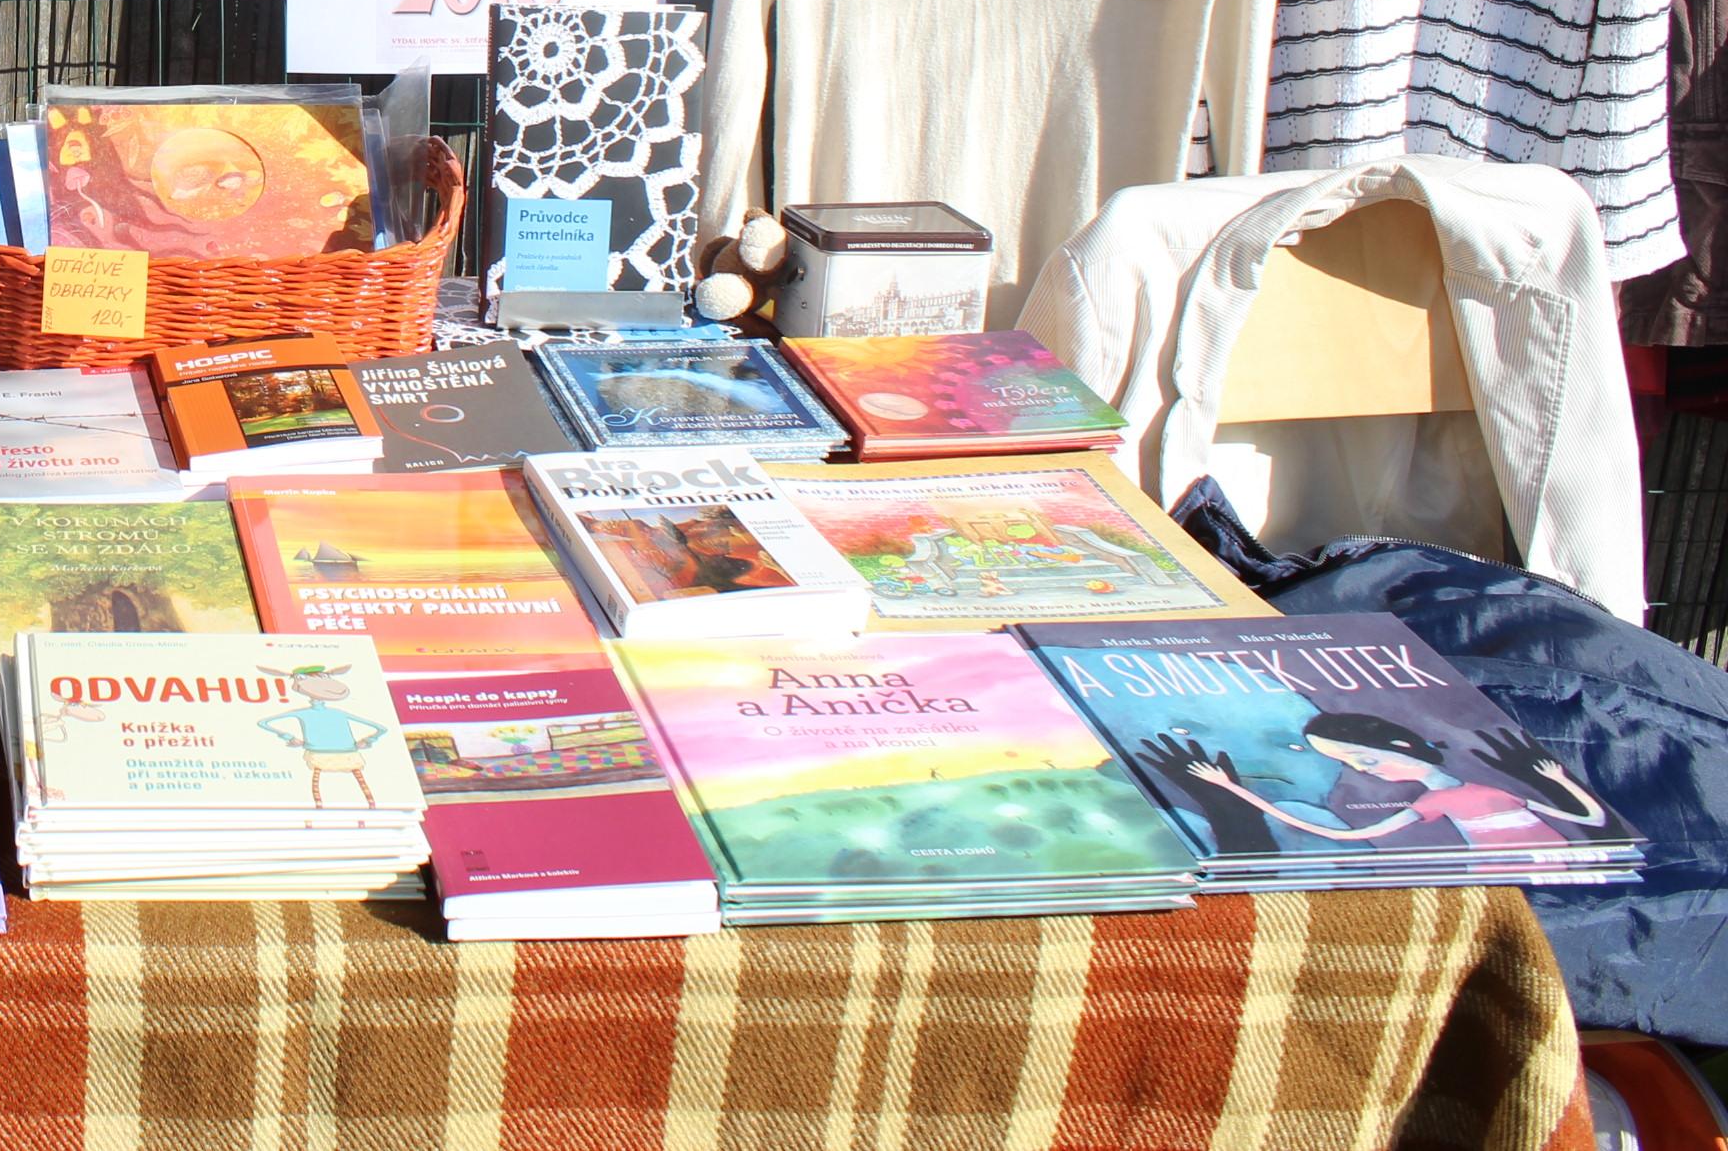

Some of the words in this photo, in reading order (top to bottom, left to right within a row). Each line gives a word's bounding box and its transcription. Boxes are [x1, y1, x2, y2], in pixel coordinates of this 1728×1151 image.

[519, 209, 589, 224] Průvodce
[518, 229, 594, 242] smrtelníka
[52, 252, 126, 276] OTÁČIVÉ
[50, 278, 132, 302] OBRÁZKY
[175, 349, 273, 371] HOSPIC
[361, 368, 420, 382] Jiřina
[427, 355, 507, 377] Šiklová
[362, 371, 494, 393] VYHOŠTĚNÁ
[20, 390, 62, 398] Frankl
[370, 391, 430, 406] SMRT
[8, 456, 73, 469] životu
[80, 457, 120, 467] ano
[586, 457, 639, 471] Ira
[544, 459, 767, 498] Byock
[560, 482, 661, 499] Dobré
[644, 487, 777, 506] umírání
[12, 517, 25, 526] V
[36, 513, 187, 527] KORUNÁCH
[43, 528, 159, 541] STROMŮ
[16, 543, 47, 555] SE
[56, 544, 89, 554] MI
[97, 541, 192, 555] ZDÁLO
[297, 583, 507, 600] PSYCHOSOCIÁLNÍ
[303, 602, 413, 616] ASPEKTY
[422, 599, 562, 614] PALIATIVNÍ
[306, 616, 368, 631] PÉČE
[1101, 637, 1152, 647] Marka
[1153, 635, 1212, 646] Míková
[1238, 634, 1274, 643] Bára
[1275, 631, 1333, 642] Valecká
[768, 668, 915, 689] Anna
[1063, 654, 1113, 699] A
[1108, 649, 1315, 698] SMUTEK
[1296, 643, 1449, 692] UTEK
[406, 692, 471, 706] Hospic
[475, 691, 500, 702] do
[503, 688, 558, 702] kapsy
[737, 698, 770, 717] a
[781, 689, 980, 716] Anička
[449, 702, 466, 711] pro
[121, 721, 196, 735] Knížka
[763, 725, 783, 737] O
[789, 724, 855, 737] životě
[862, 726, 889, 735] na
[895, 722, 980, 735] začátku
[123, 738, 135, 747] o
[144, 735, 216, 749] přežití
[824, 741, 836, 749] a
[842, 740, 870, 749] na
[871, 736, 937, 748] konci
[125, 757, 206, 769] Okamžitá
[211, 760, 268, 771] pomoc
[127, 769, 155, 782] při
[233, 768, 293, 780] úzkosti
[129, 782, 141, 791] a
[145, 780, 203, 792] panice
